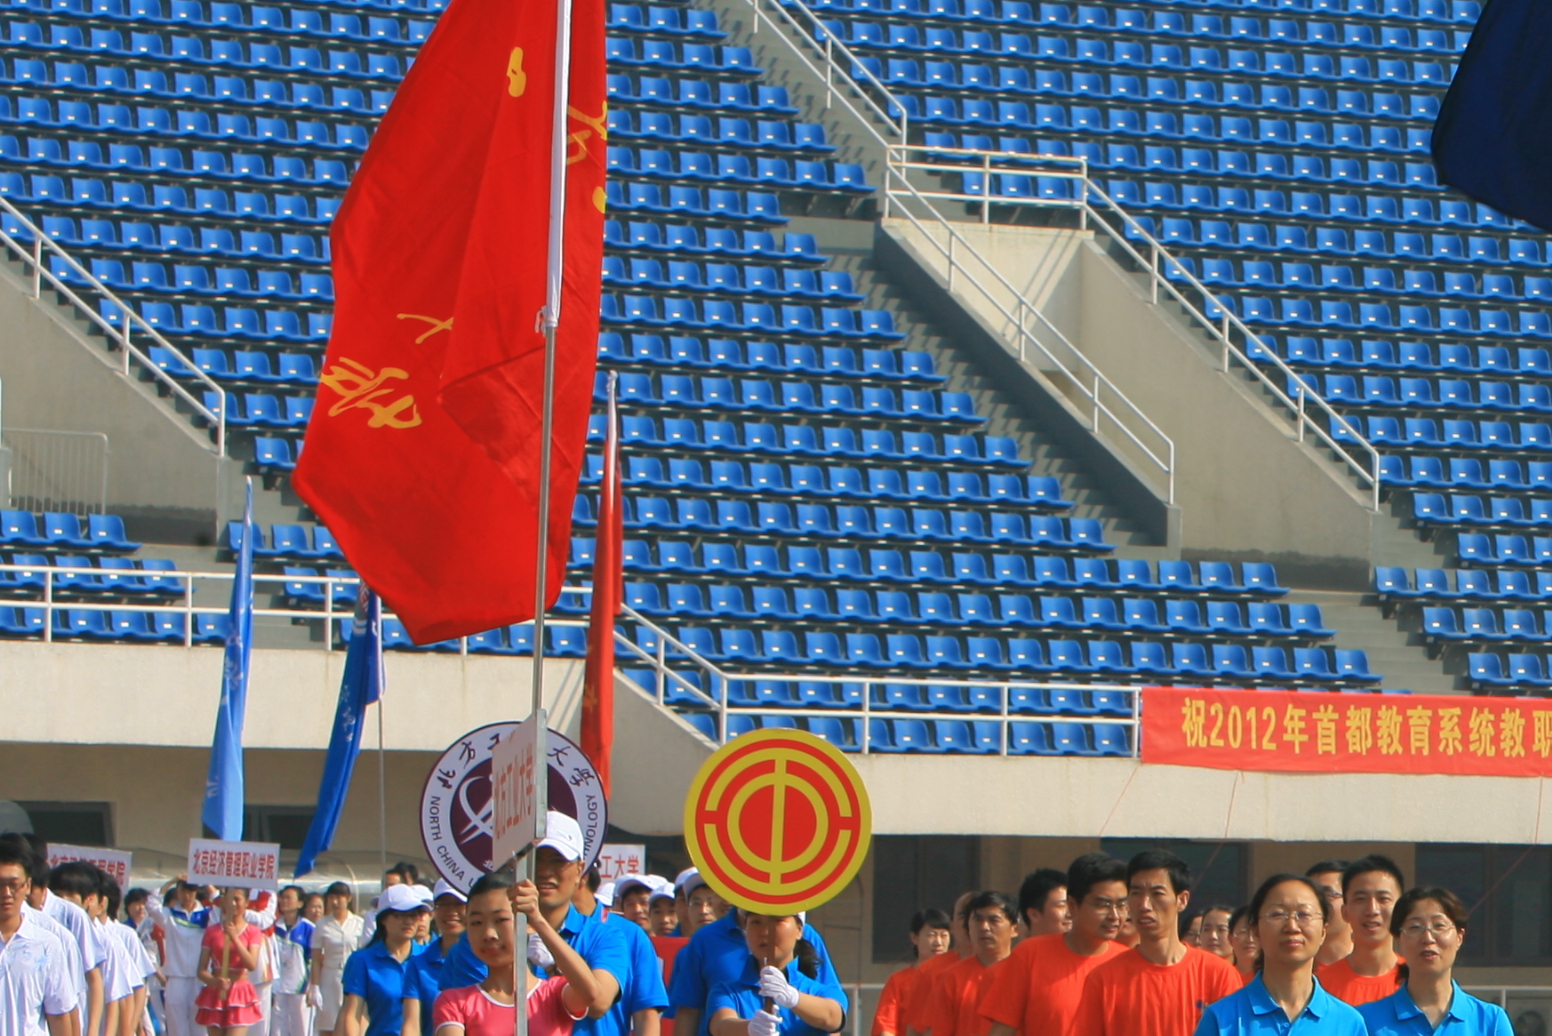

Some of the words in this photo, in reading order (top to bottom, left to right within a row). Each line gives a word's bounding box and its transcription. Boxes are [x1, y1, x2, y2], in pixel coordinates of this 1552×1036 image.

[193, 848, 275, 880] 北京经济管理职业学院
[429, 795, 443, 841] NORTH
[437, 845, 466, 881] CHINA
